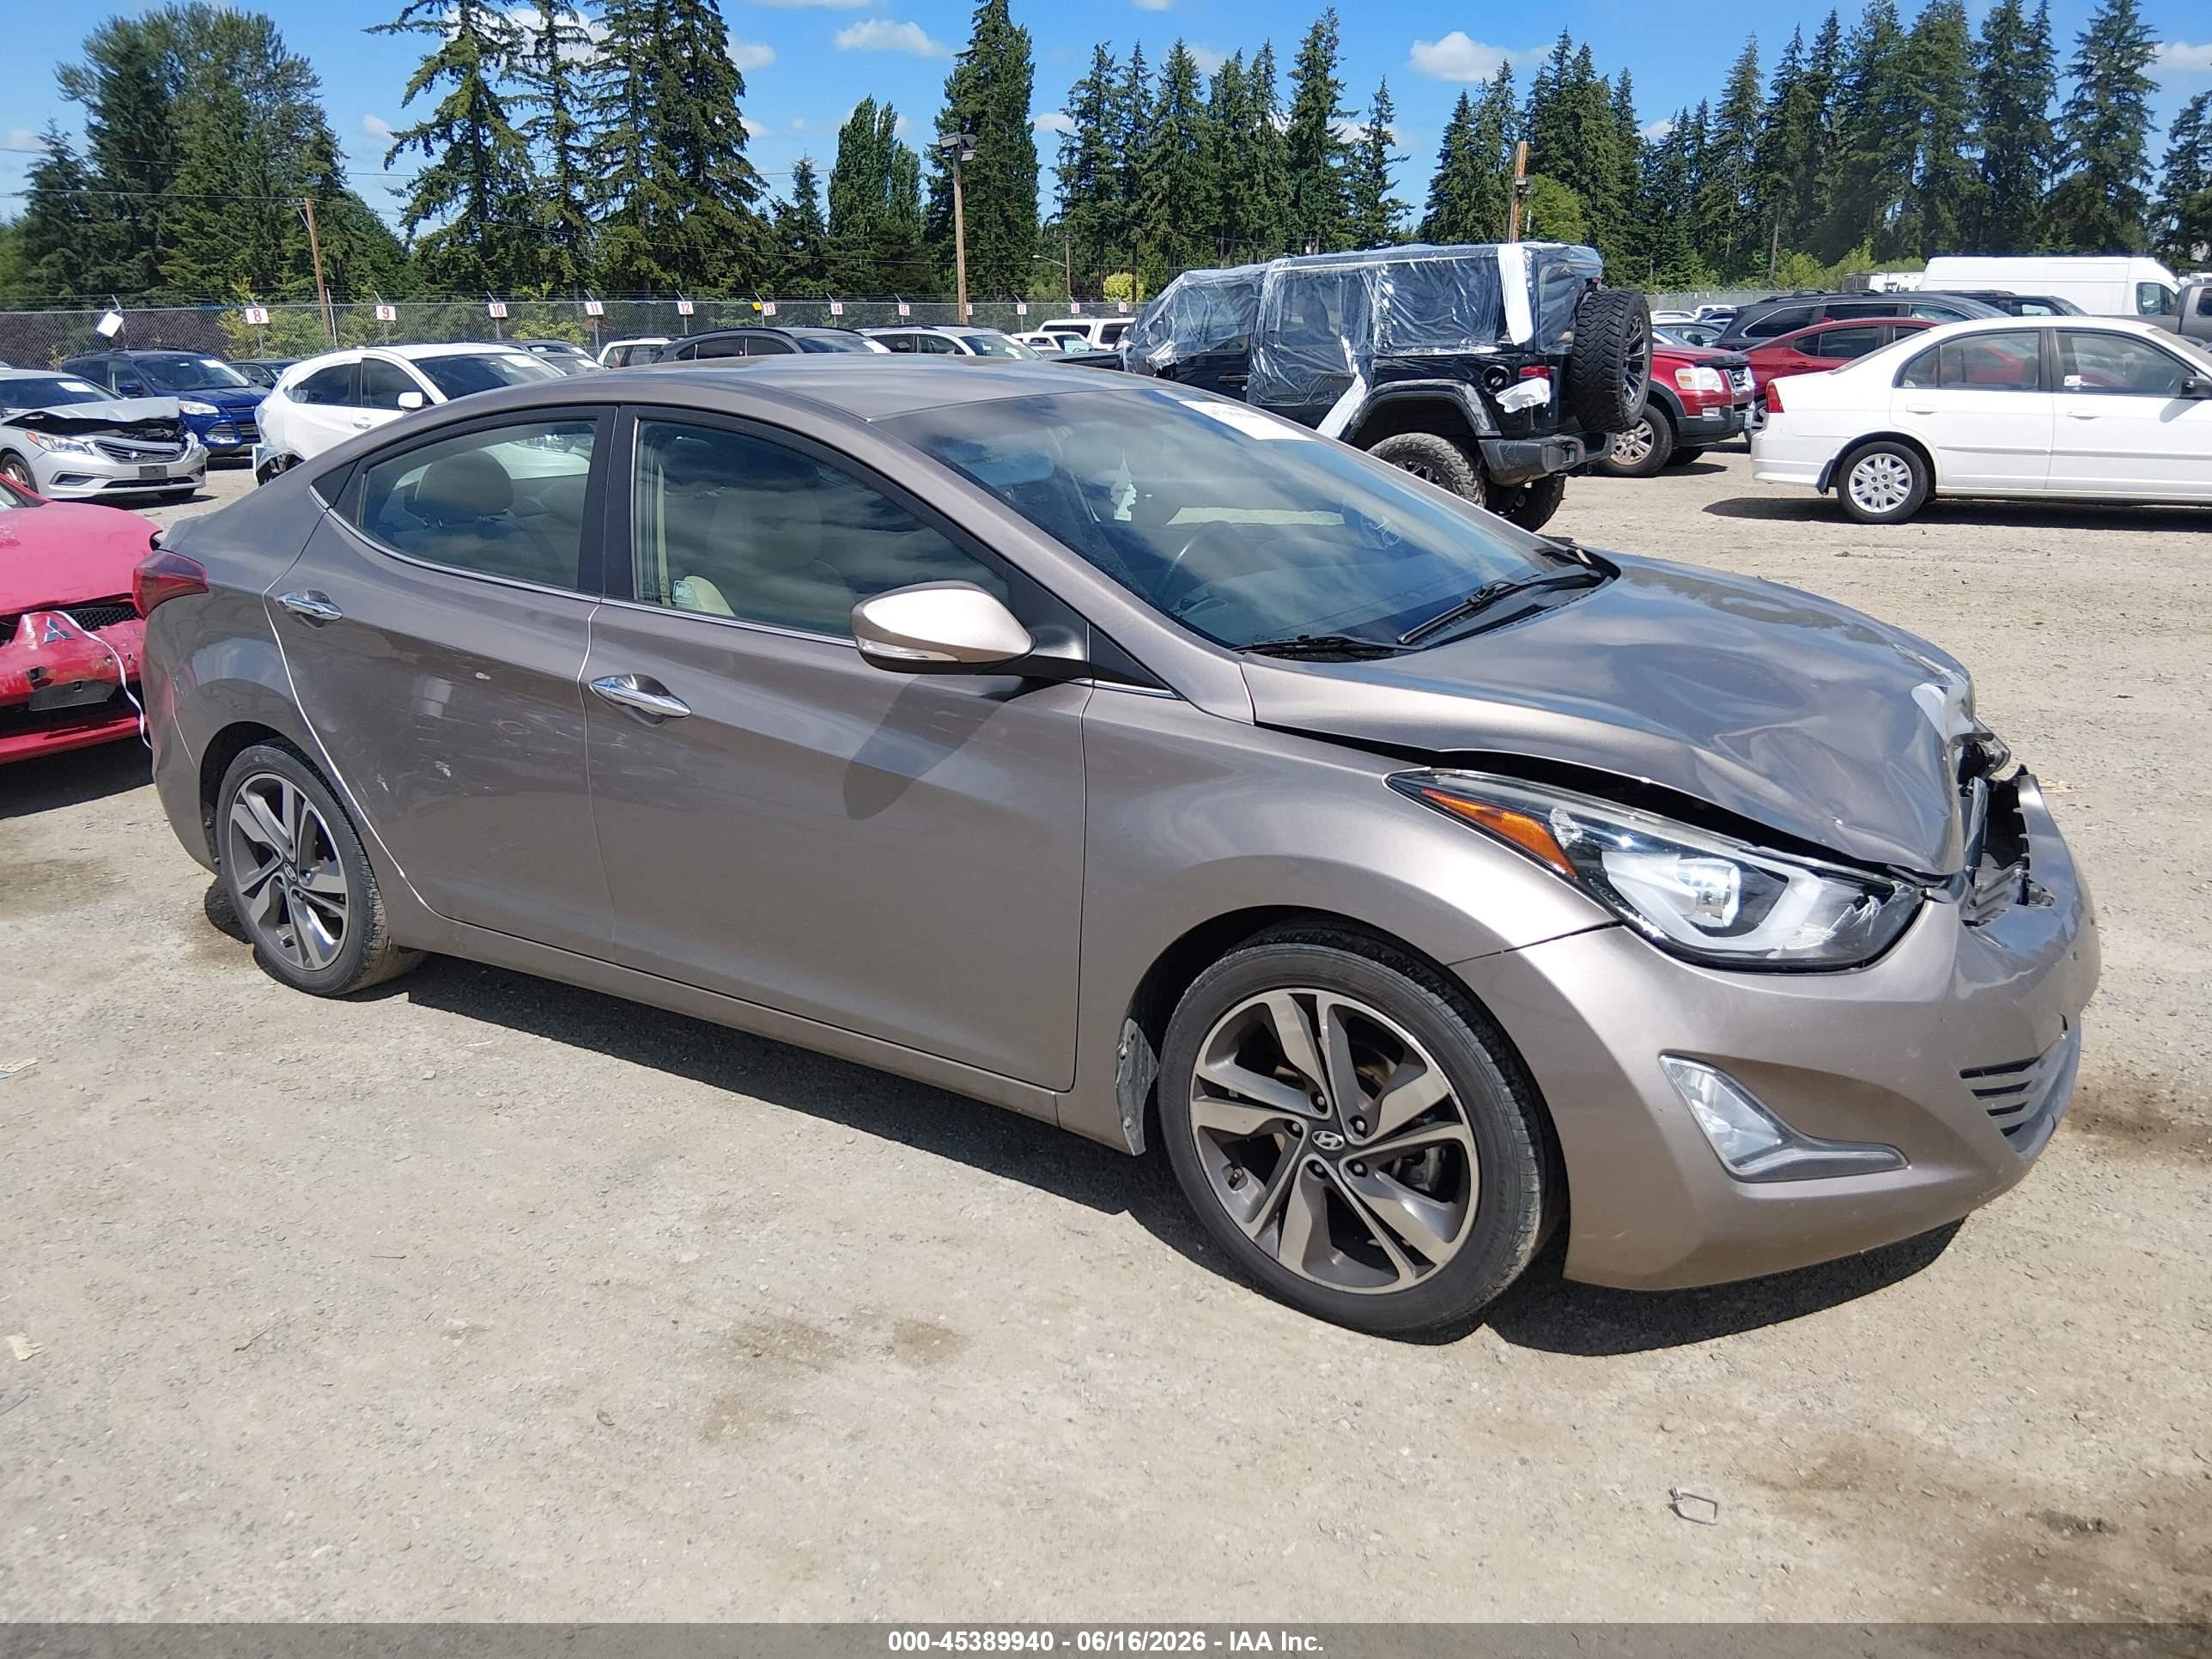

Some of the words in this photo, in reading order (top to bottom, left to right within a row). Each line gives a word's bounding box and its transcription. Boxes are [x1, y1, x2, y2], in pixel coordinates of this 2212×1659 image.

[382, 307, 390, 319] 9
[492, 305, 504, 316] 10
[590, 303, 599, 314] 11
[680, 303, 691, 313] 12
[765, 303, 774, 314] 13
[833, 304, 841, 314] 14
[901, 305, 908, 315] 15
[253, 309, 262, 322] 8
